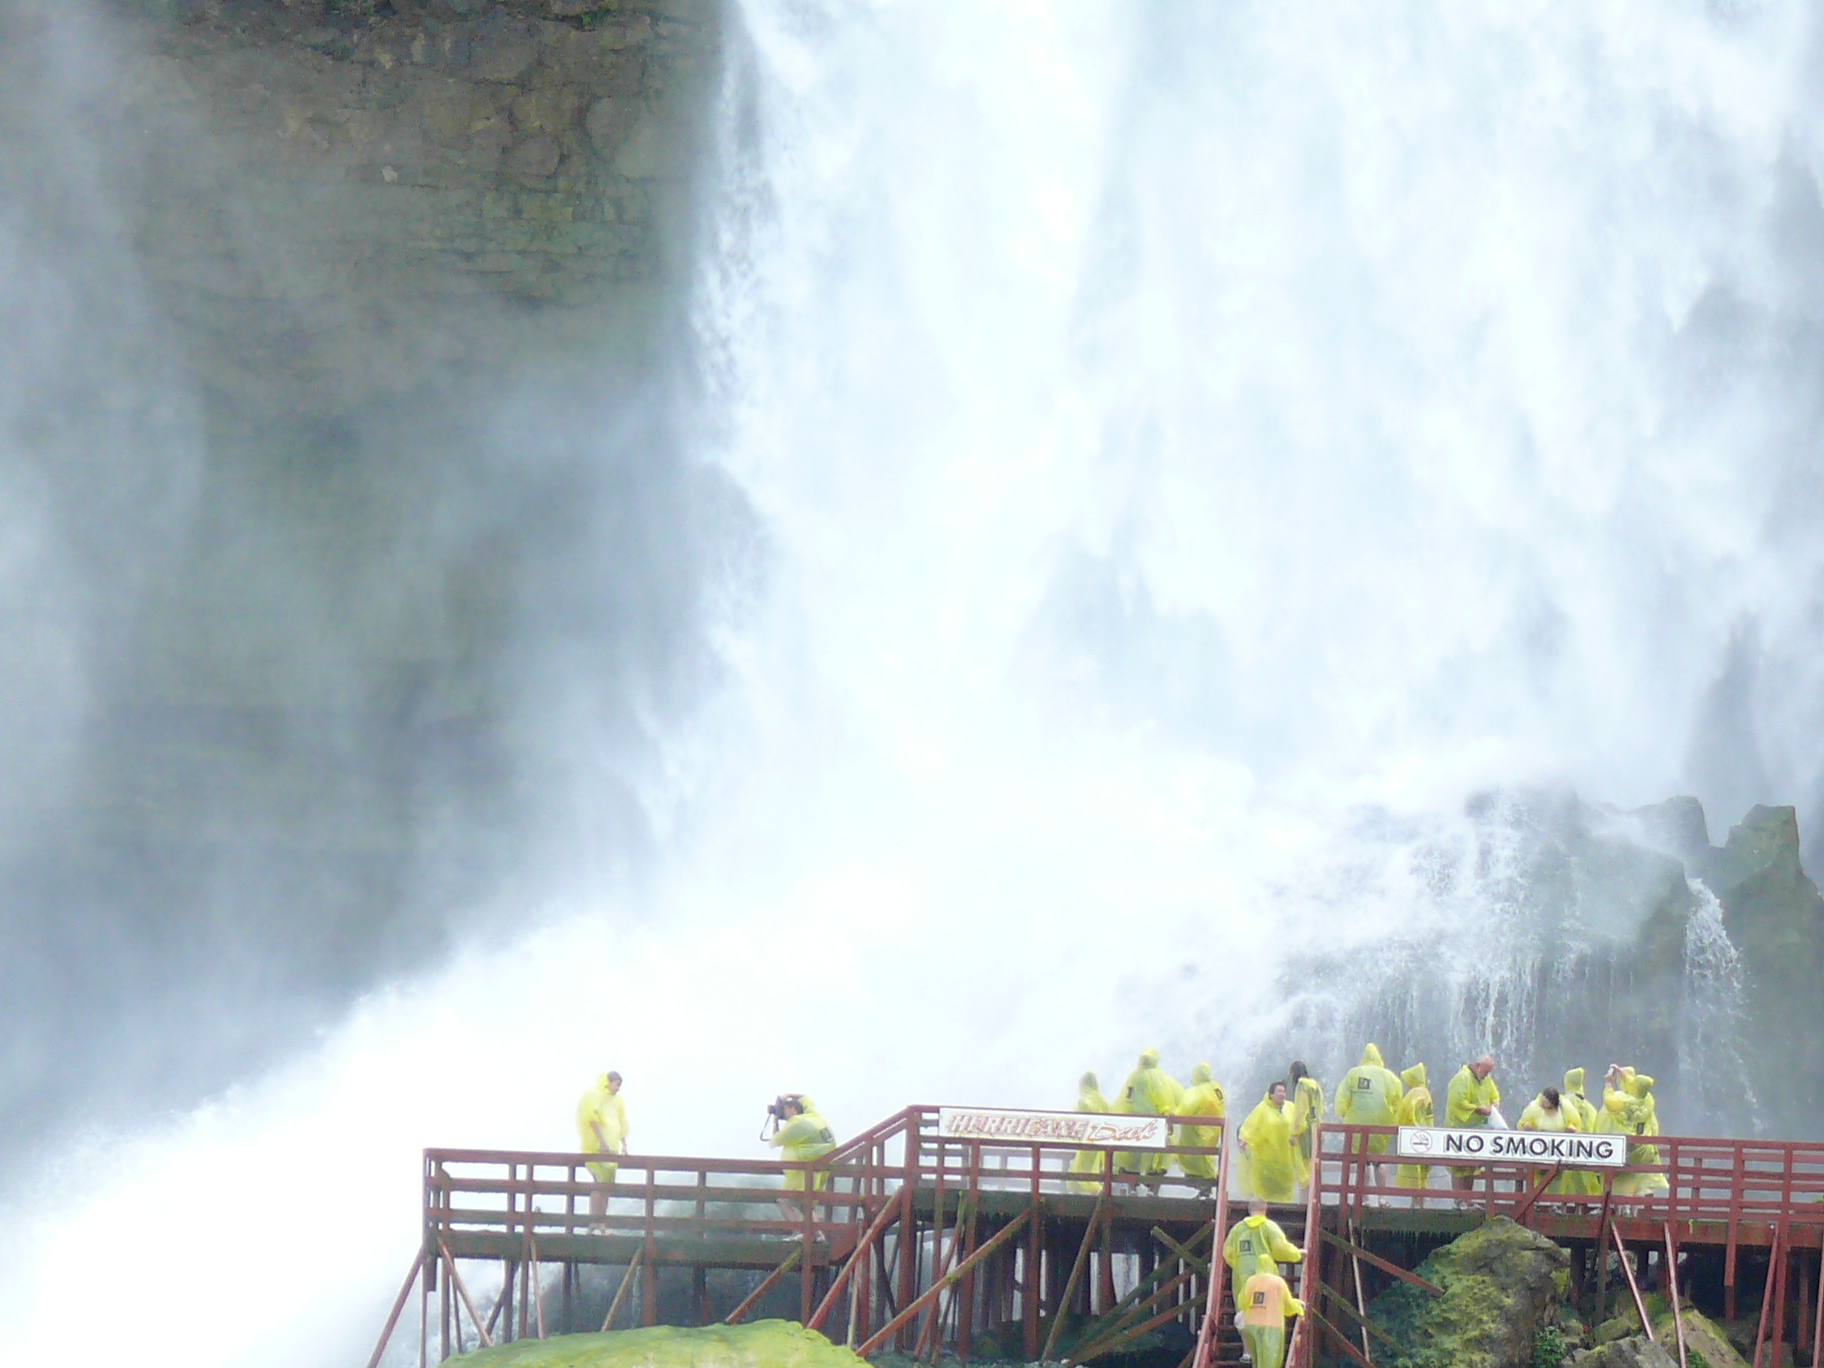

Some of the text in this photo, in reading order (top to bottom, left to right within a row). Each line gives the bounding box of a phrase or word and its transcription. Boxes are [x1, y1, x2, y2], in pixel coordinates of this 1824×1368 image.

[948, 1114, 1090, 1140] HURRICANE
[1445, 1133, 1614, 1160] NO SMOKING
